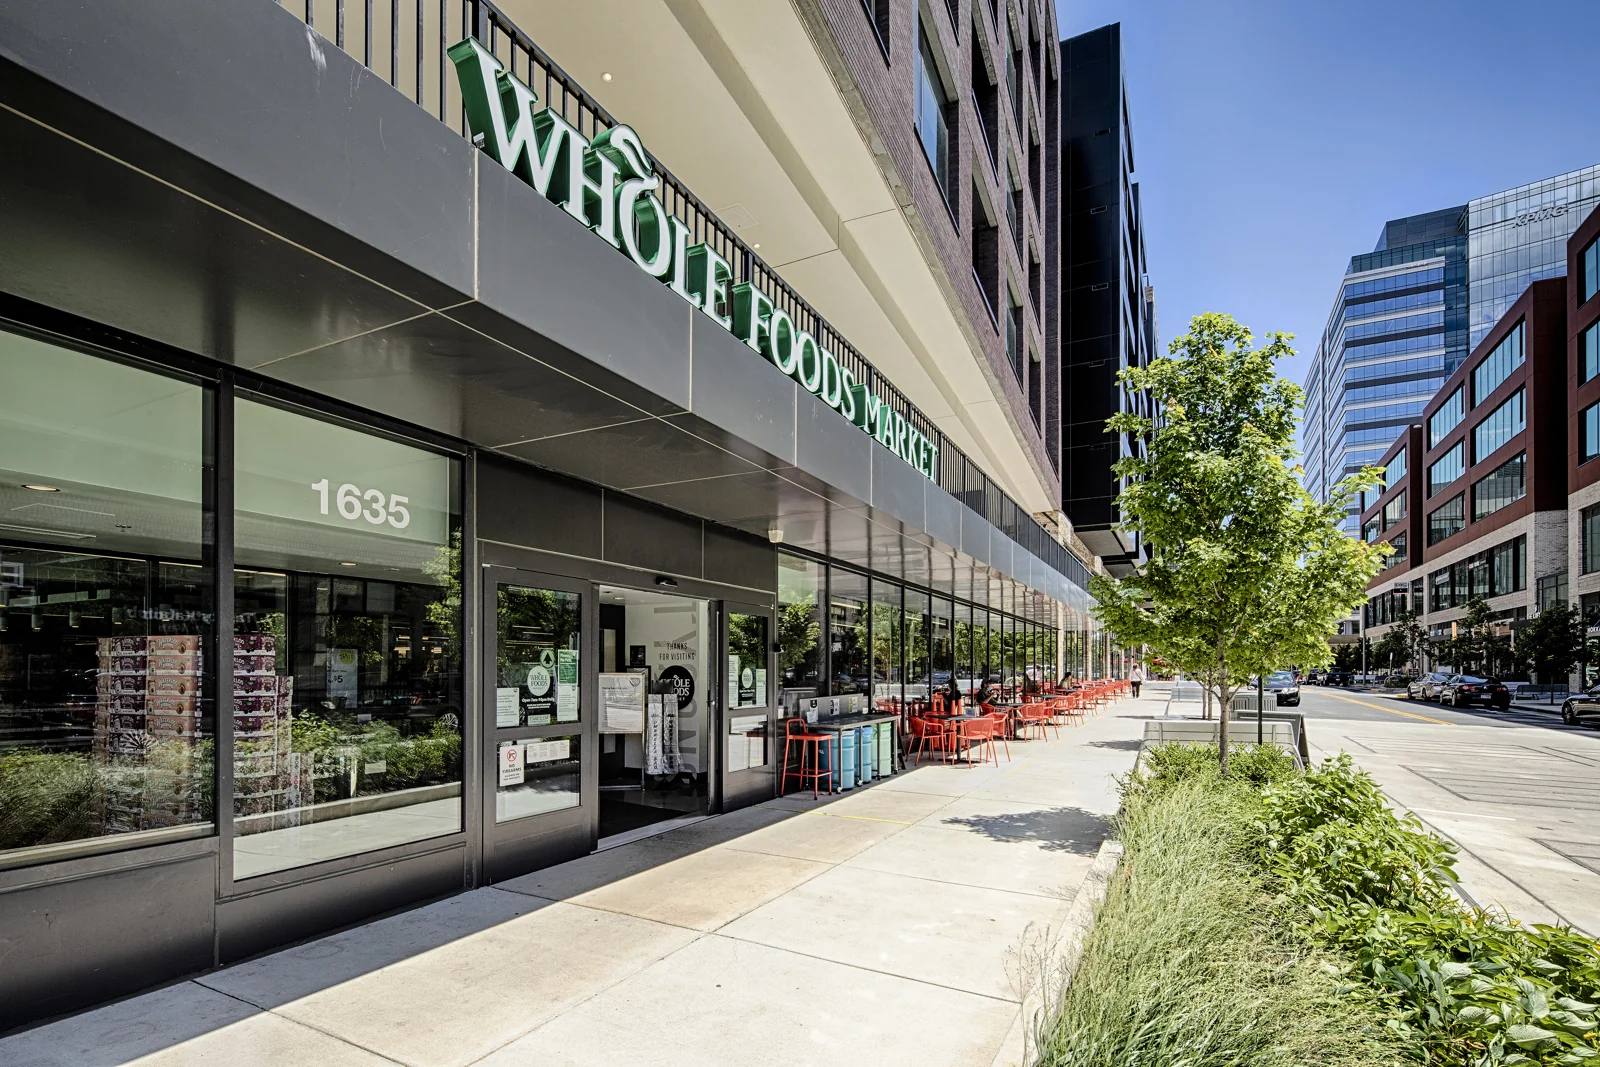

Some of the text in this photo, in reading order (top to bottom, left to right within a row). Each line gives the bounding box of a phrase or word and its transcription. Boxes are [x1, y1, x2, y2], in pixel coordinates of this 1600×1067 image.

[1512, 205, 1569, 229] KPMG
[447, 35, 939, 483] WHOLE FOODS MARKET
[311, 478, 410, 529] 1635
[667, 642, 688, 650] THANKS
[671, 652, 695, 660] VISITING
[333, 675, 344, 684] $5
